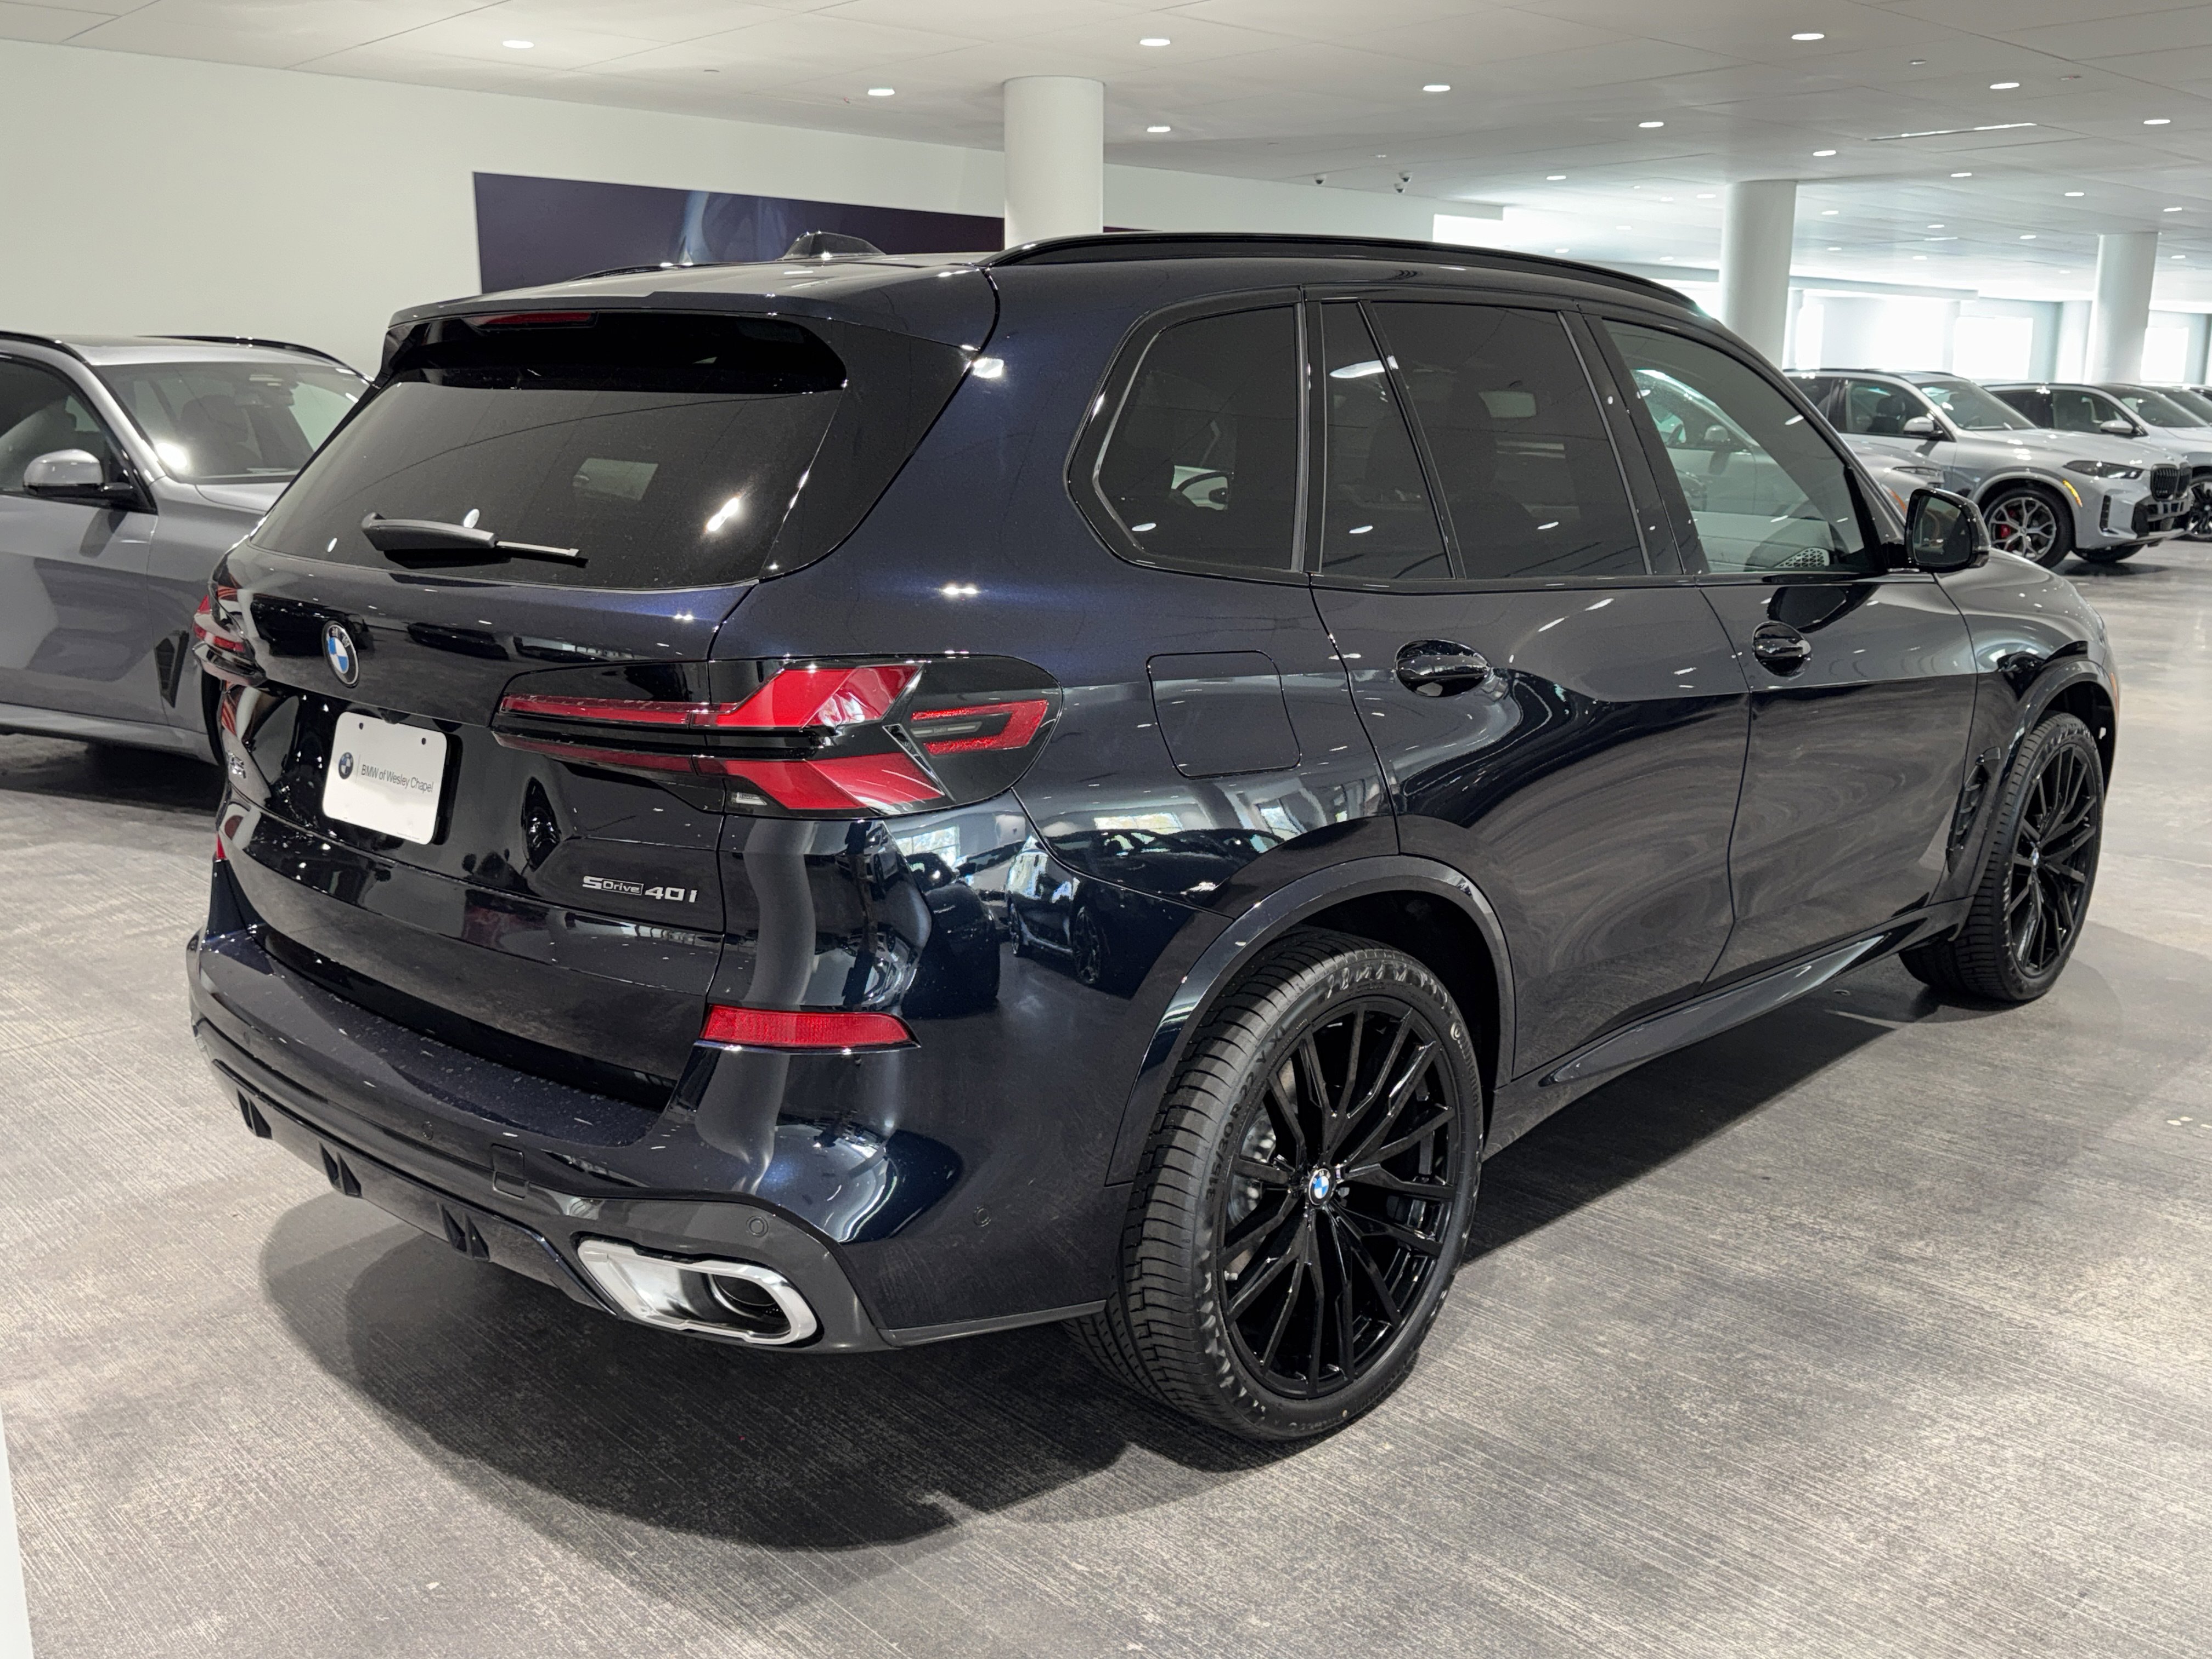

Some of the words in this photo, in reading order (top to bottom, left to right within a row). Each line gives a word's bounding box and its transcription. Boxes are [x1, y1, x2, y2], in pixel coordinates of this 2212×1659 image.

[360, 764, 379, 780] BMW
[379, 769, 386, 781] of
[386, 771, 410, 789] Wesley
[411, 776, 434, 793] Chapel
[1207, 1121, 1234, 1202] 315/30
[1230, 1103, 1242, 1119] R
[1239, 1071, 1255, 1098] 22
[1256, 1050, 1267, 1063] Y
[1269, 1026, 1286, 1049] XL
